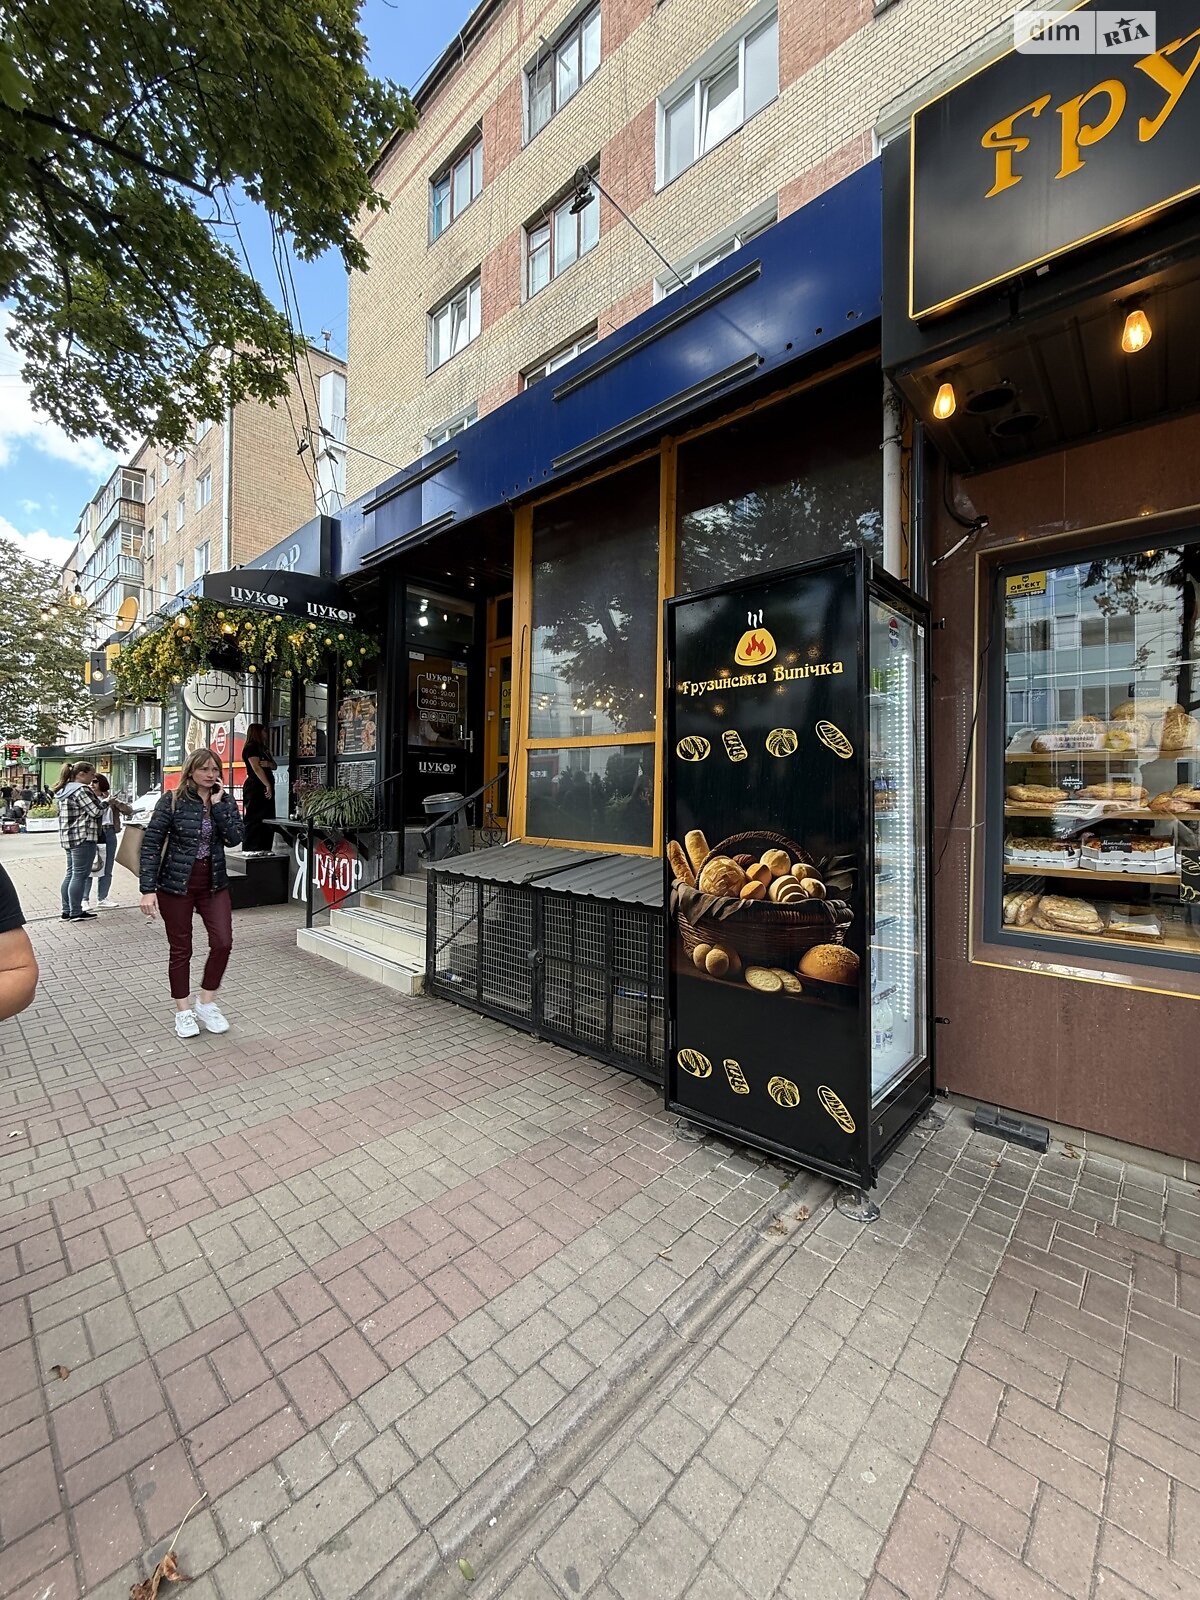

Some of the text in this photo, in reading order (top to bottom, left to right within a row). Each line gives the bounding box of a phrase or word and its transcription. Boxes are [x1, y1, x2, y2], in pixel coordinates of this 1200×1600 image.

[230, 586, 289, 608] ЦУКОР
[306, 602, 357, 622] ЦУКОР
[425, 672, 452, 683] ЦУКОР
[772, 661, 844, 682] Випічка
[418, 761, 457, 773] ЦУКОР
